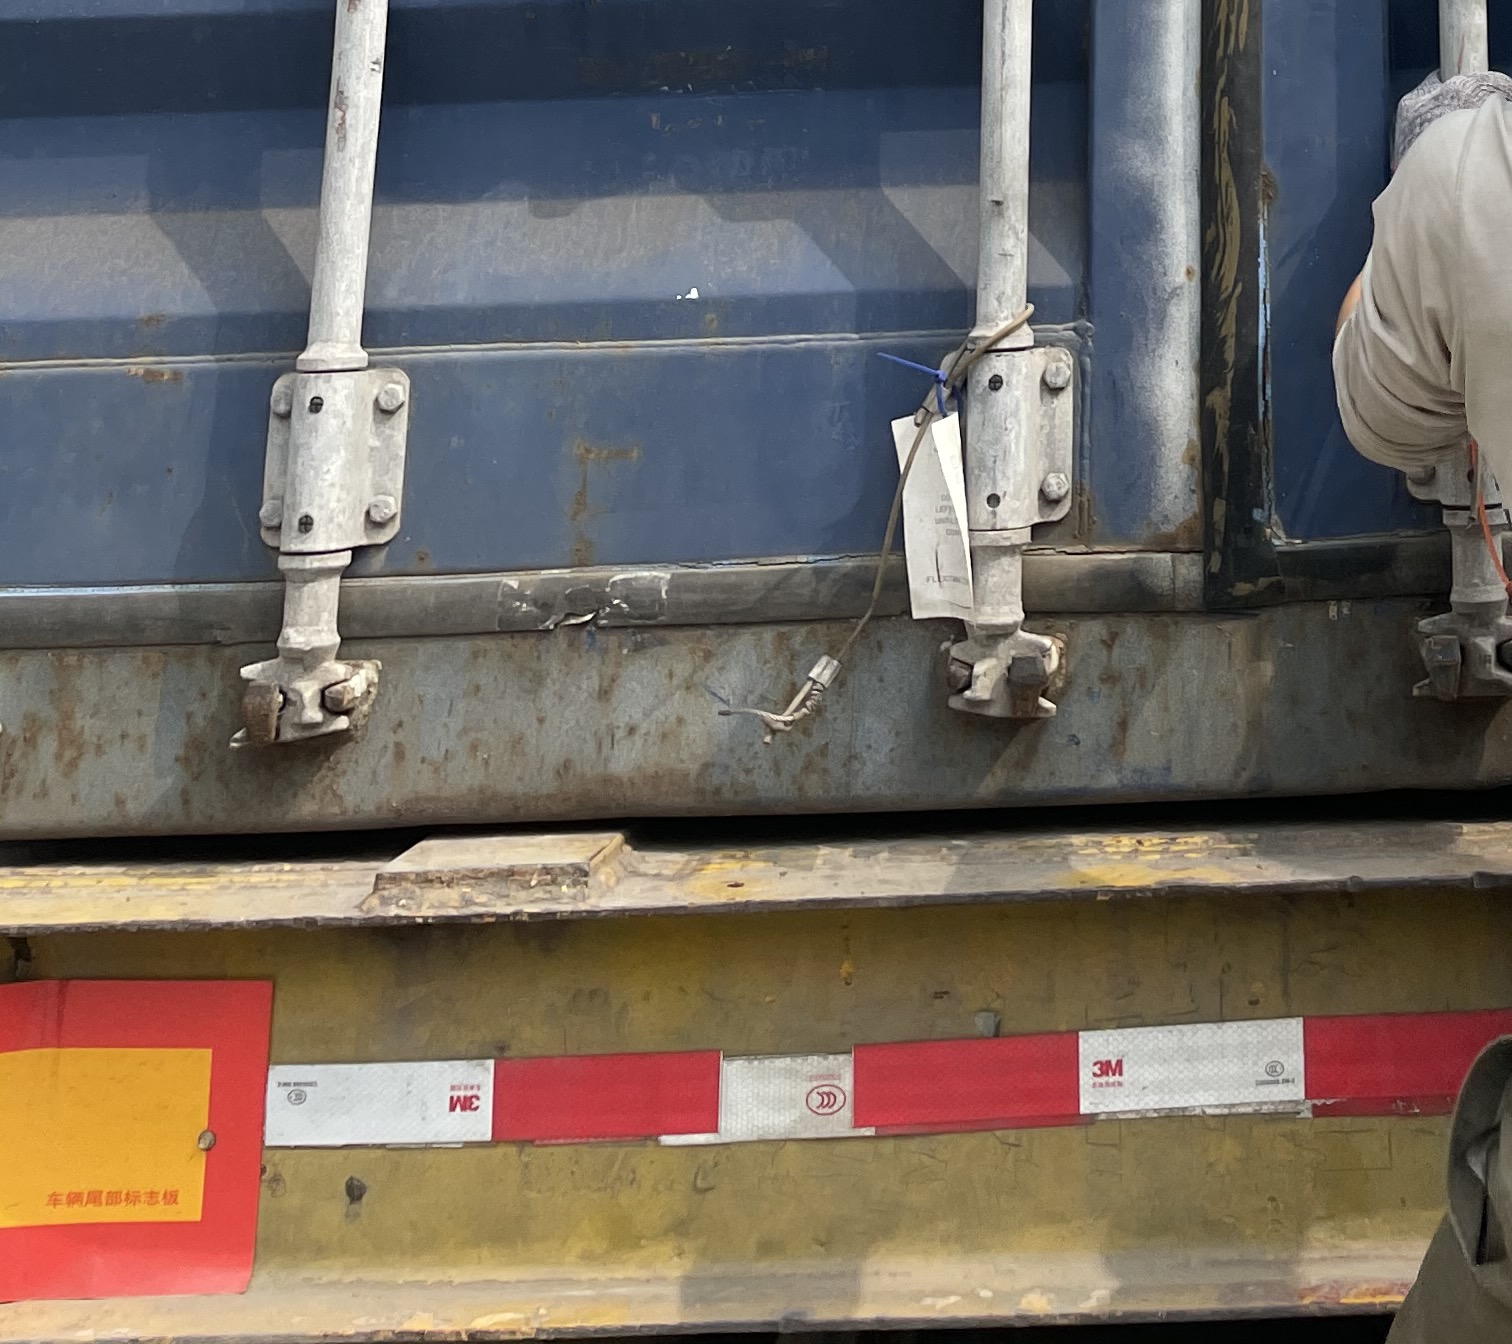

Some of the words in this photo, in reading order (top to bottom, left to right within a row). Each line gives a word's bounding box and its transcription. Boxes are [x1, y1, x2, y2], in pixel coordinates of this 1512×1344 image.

[1091, 1058, 1124, 1078] 3M
[449, 1095, 480, 1113] 3M
[46, 1189, 179, 1209] 车辆尾部标志板
